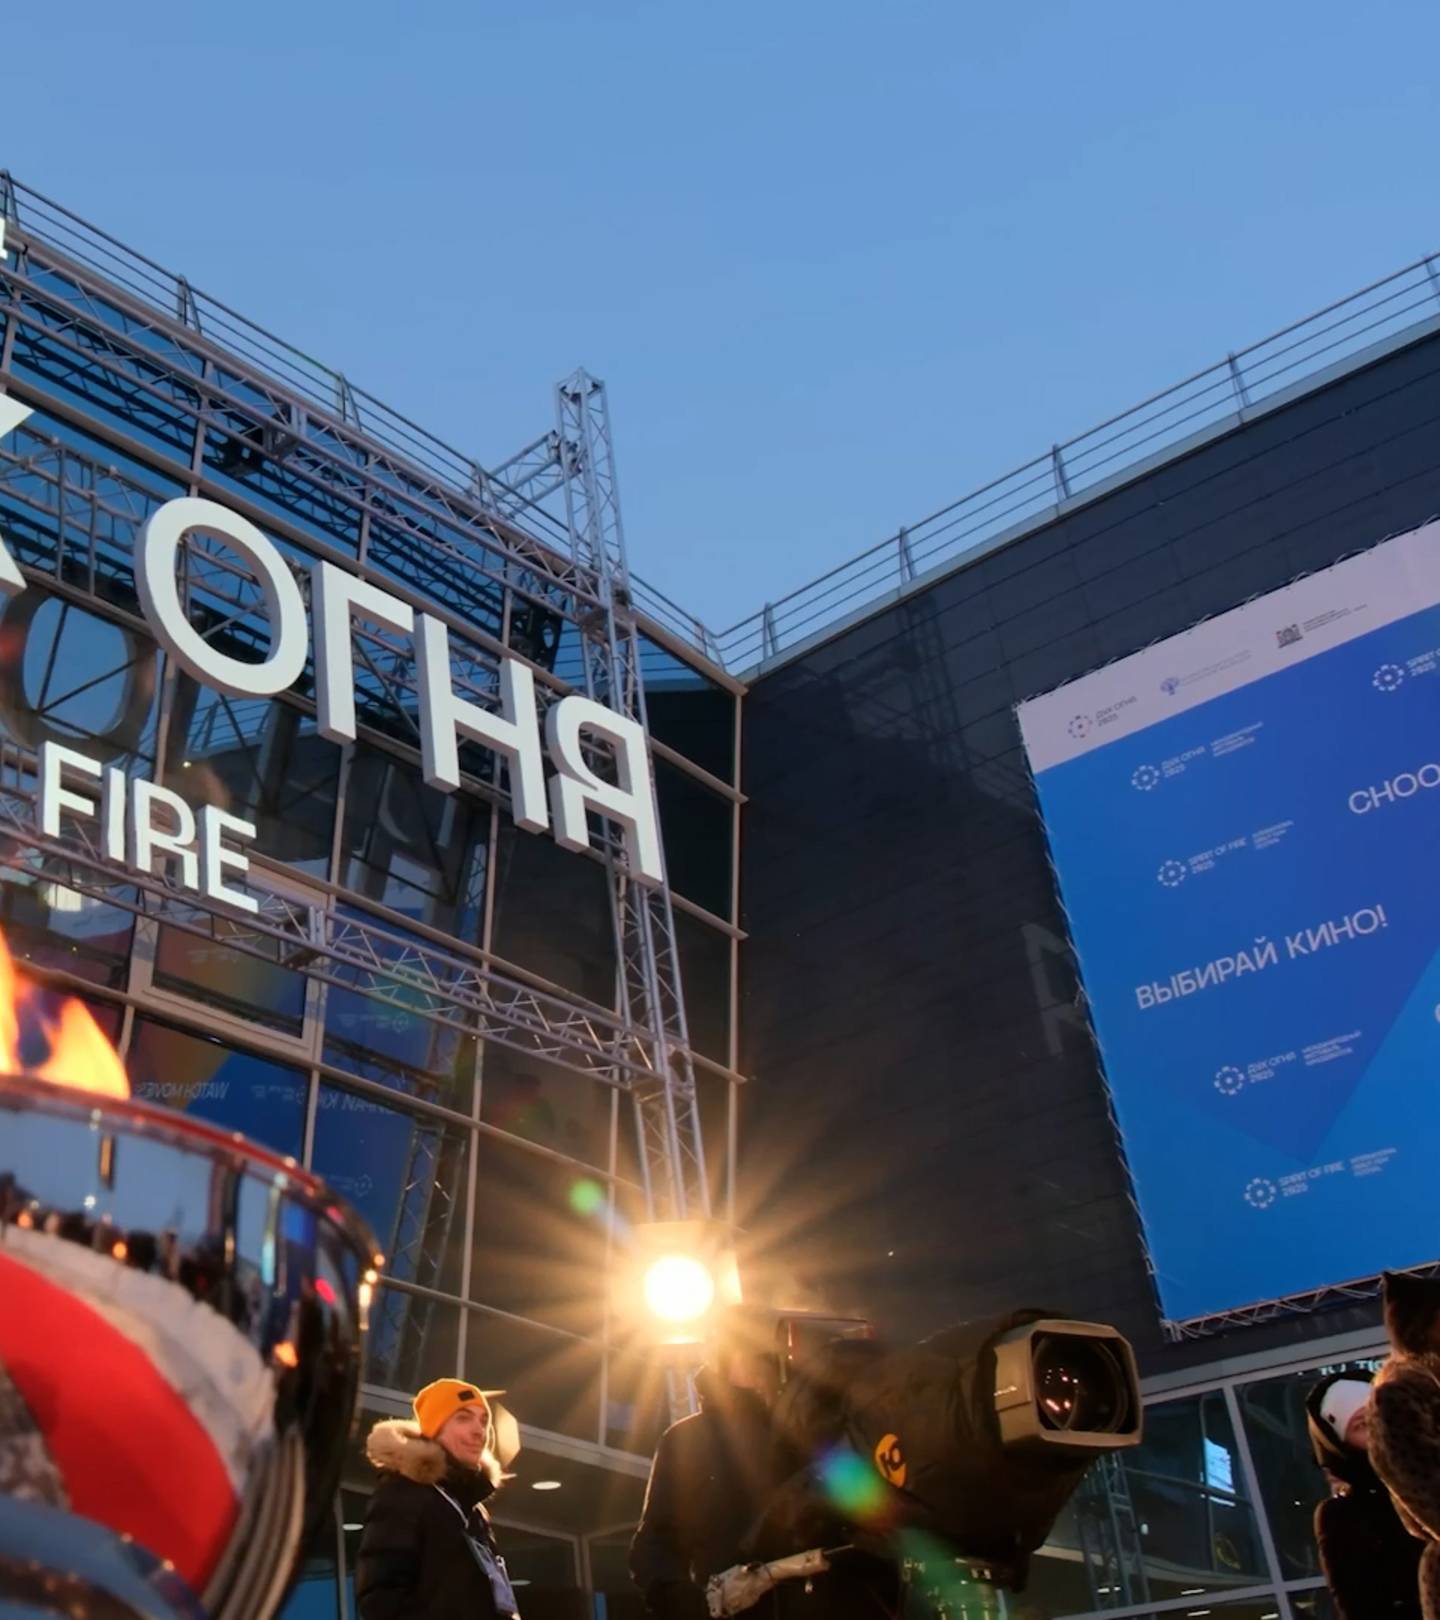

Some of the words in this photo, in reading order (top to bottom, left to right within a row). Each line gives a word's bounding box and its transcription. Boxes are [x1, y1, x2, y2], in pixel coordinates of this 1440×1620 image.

[135, 497, 664, 888] ОГНЯ
[39, 741, 258, 913] FIRE
[1348, 763, 1440, 814] CHOO
[1135, 937, 1278, 1010] ВЫБИРАЙ
[1286, 905, 1389, 960] КИНО!
